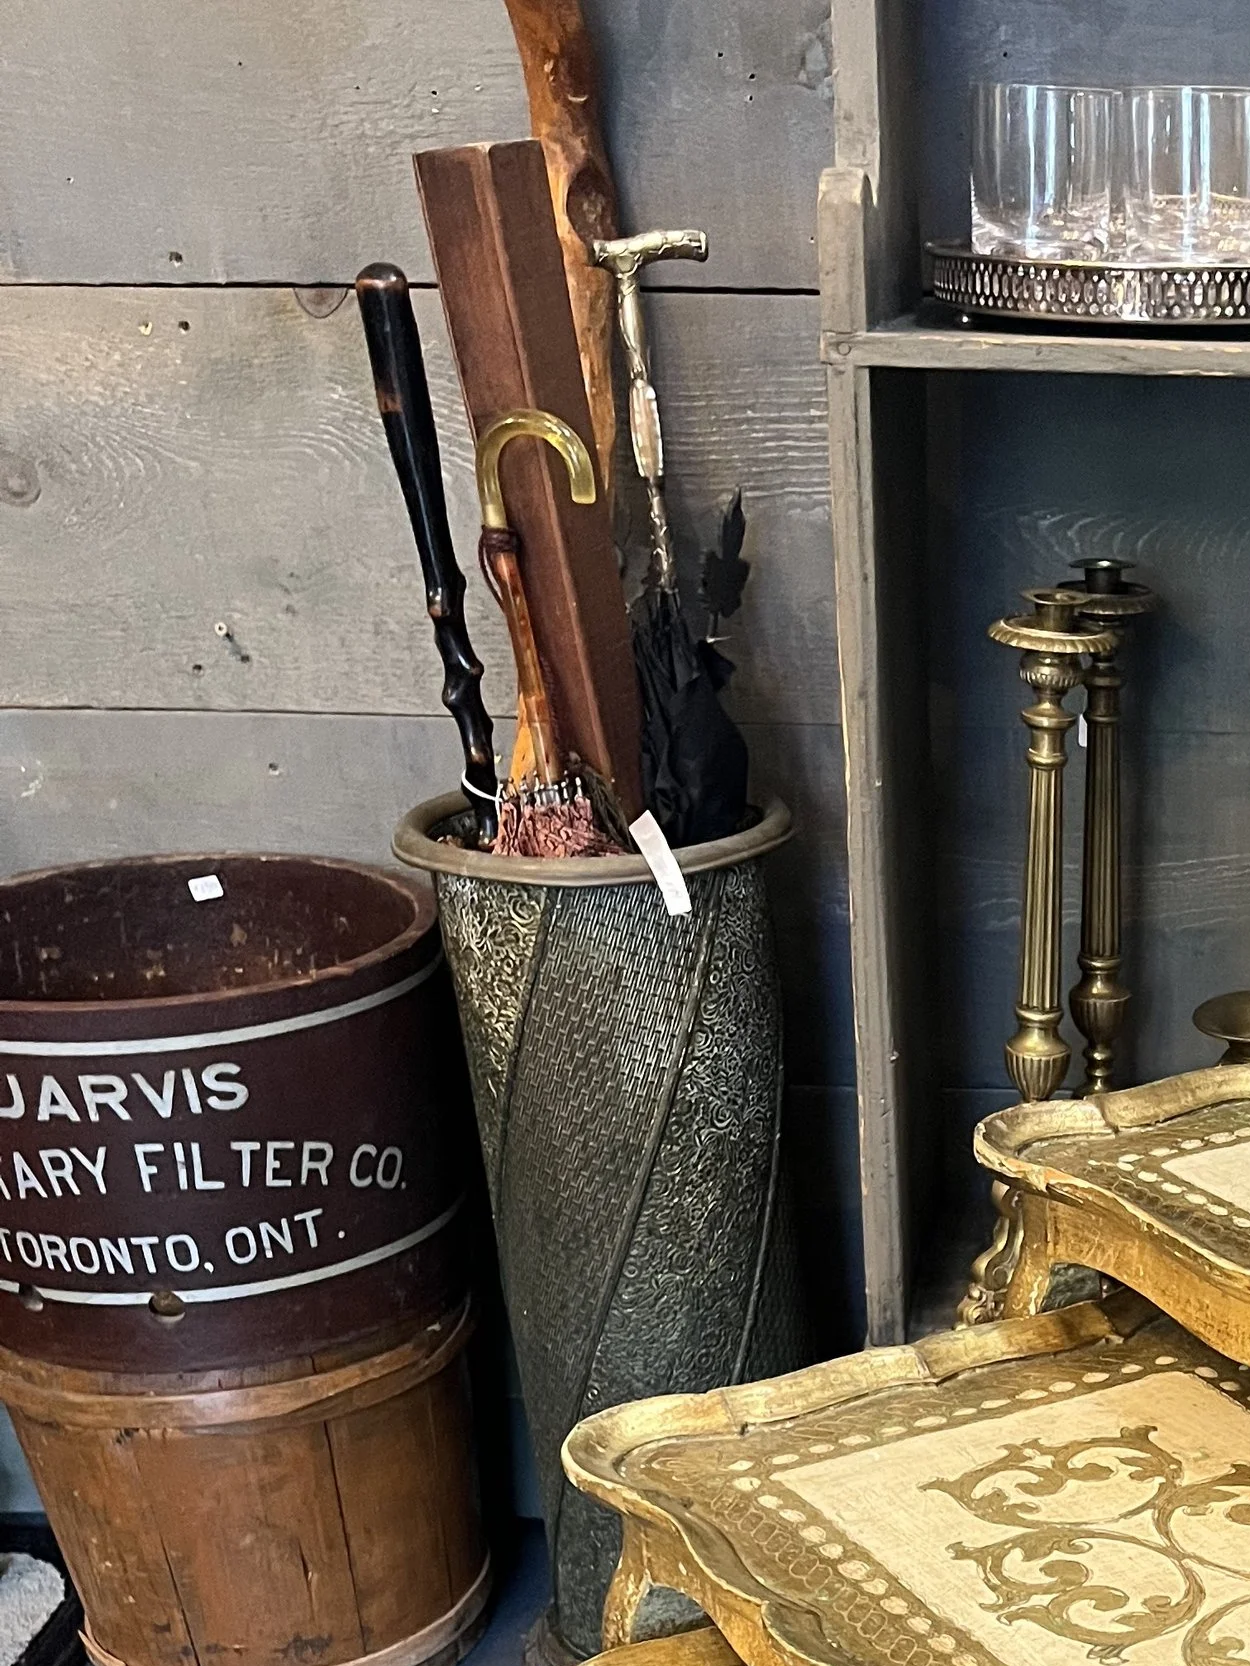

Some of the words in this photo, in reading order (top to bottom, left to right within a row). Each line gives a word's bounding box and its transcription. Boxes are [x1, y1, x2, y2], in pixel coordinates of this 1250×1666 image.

[0, 1062, 249, 1122] JARVIS
[134, 1140, 334, 1193] FILTER
[349, 1143, 406, 1190] CO.
[0, 1227, 215, 1275] TORONTO,
[225, 1208, 346, 1264] ONT.
